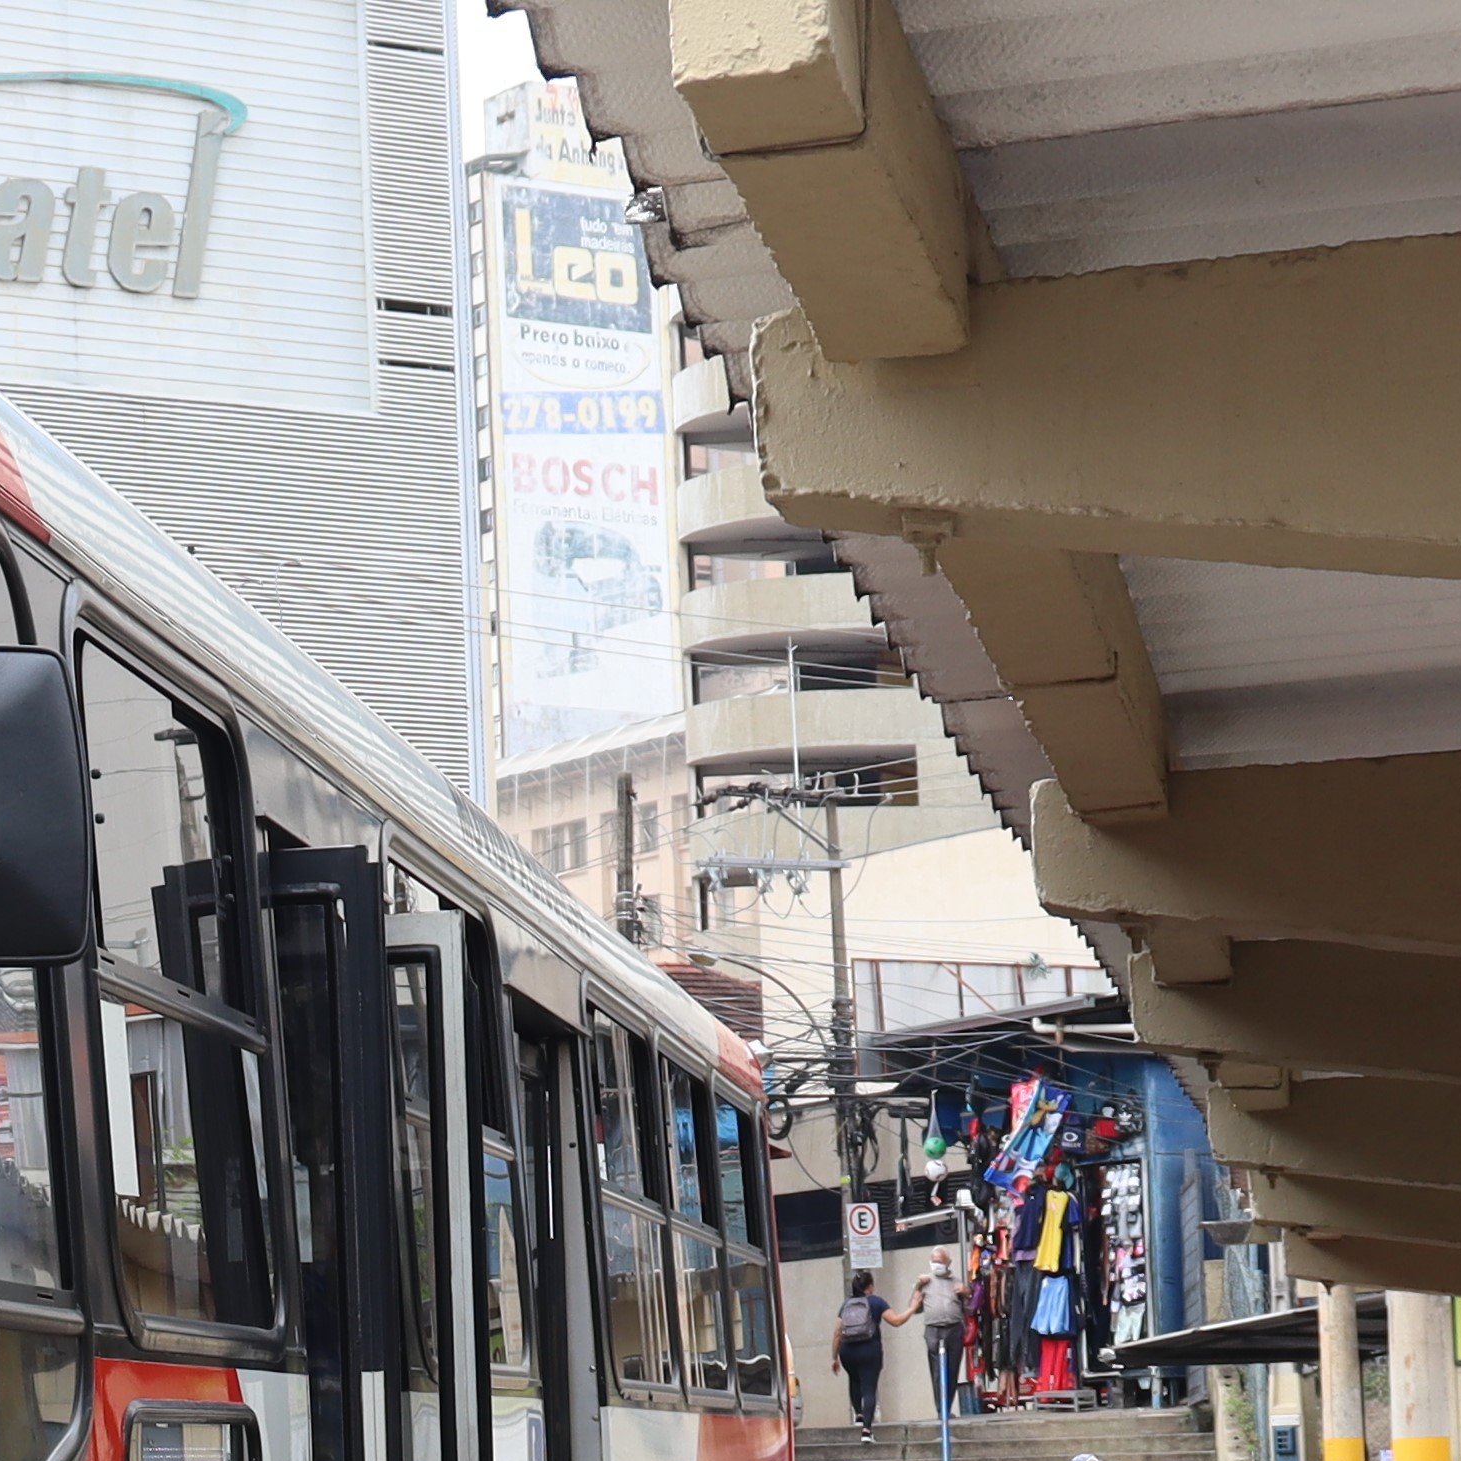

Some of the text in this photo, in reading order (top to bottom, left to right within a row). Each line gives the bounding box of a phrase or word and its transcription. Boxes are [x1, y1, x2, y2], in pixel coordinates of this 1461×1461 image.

[515, 207, 638, 305] Leo
[573, 330, 620, 351] baixo
[504, 396, 657, 429] 278-0199
[512, 453, 659, 506] BOSCH
[858, 1211, 868, 1229] E
